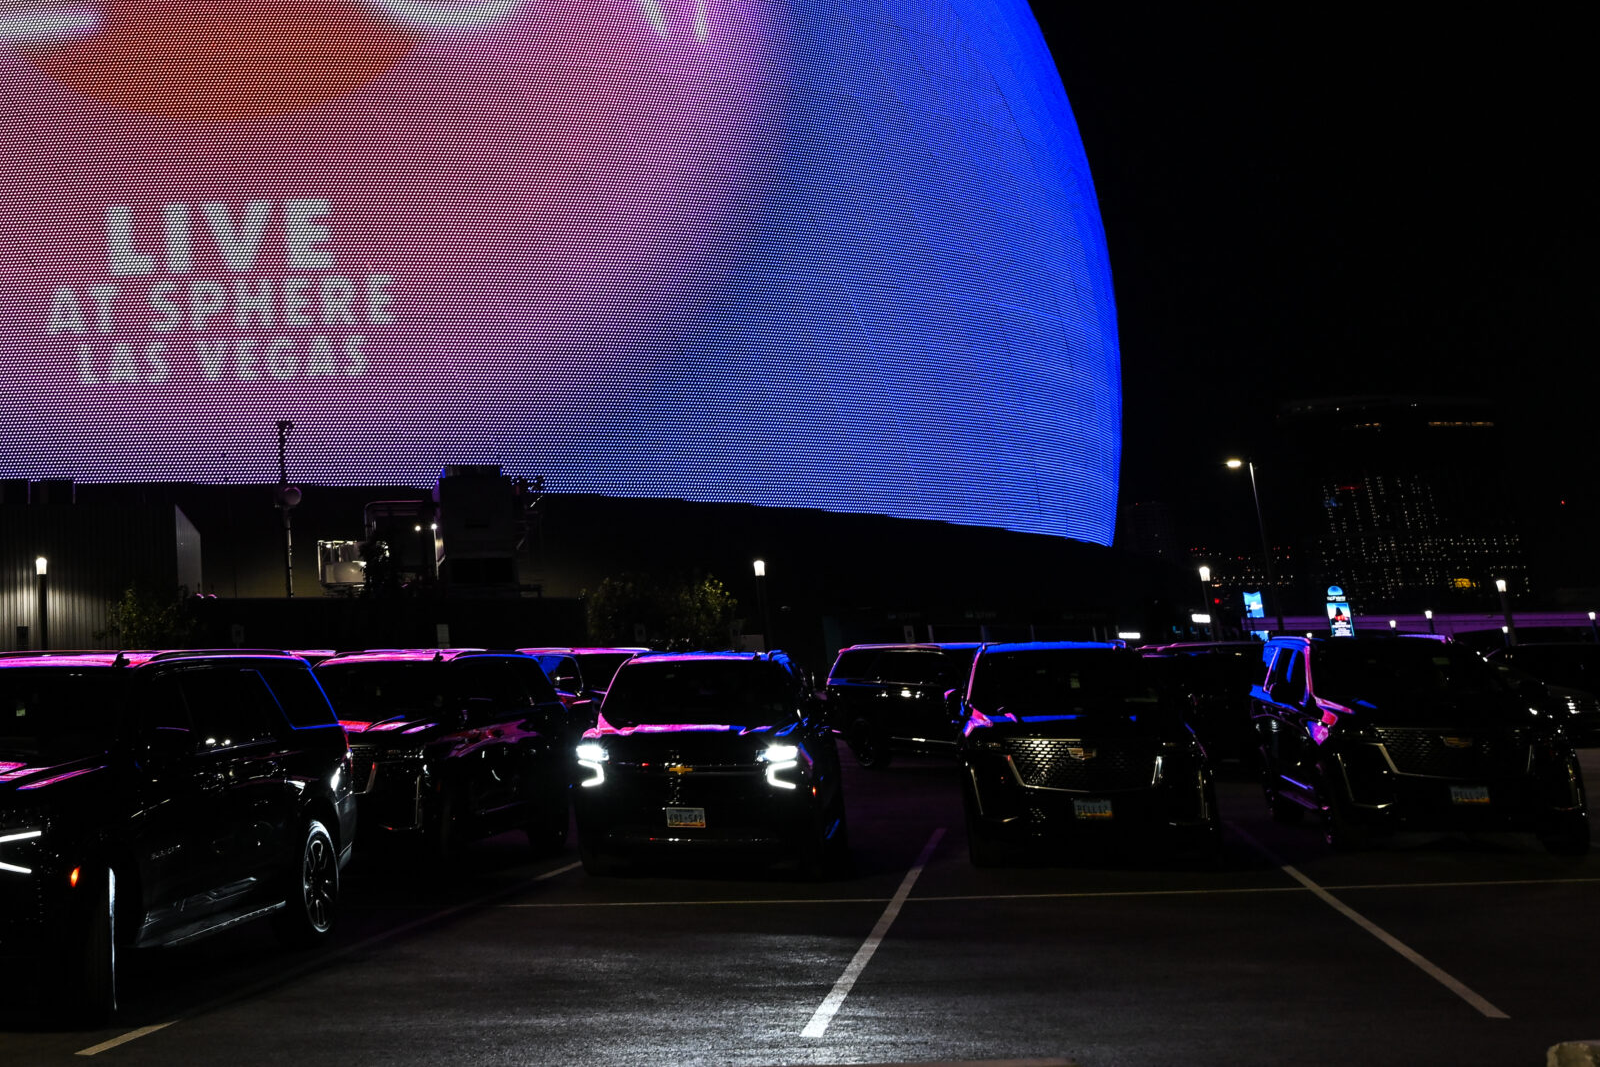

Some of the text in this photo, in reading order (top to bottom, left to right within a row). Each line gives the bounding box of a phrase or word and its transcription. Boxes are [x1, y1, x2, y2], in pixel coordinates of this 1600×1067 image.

[106, 198, 337, 276] LIVE
[47, 275, 397, 336] AT SPHERE
[77, 336, 368, 384] LAS VEGAS
